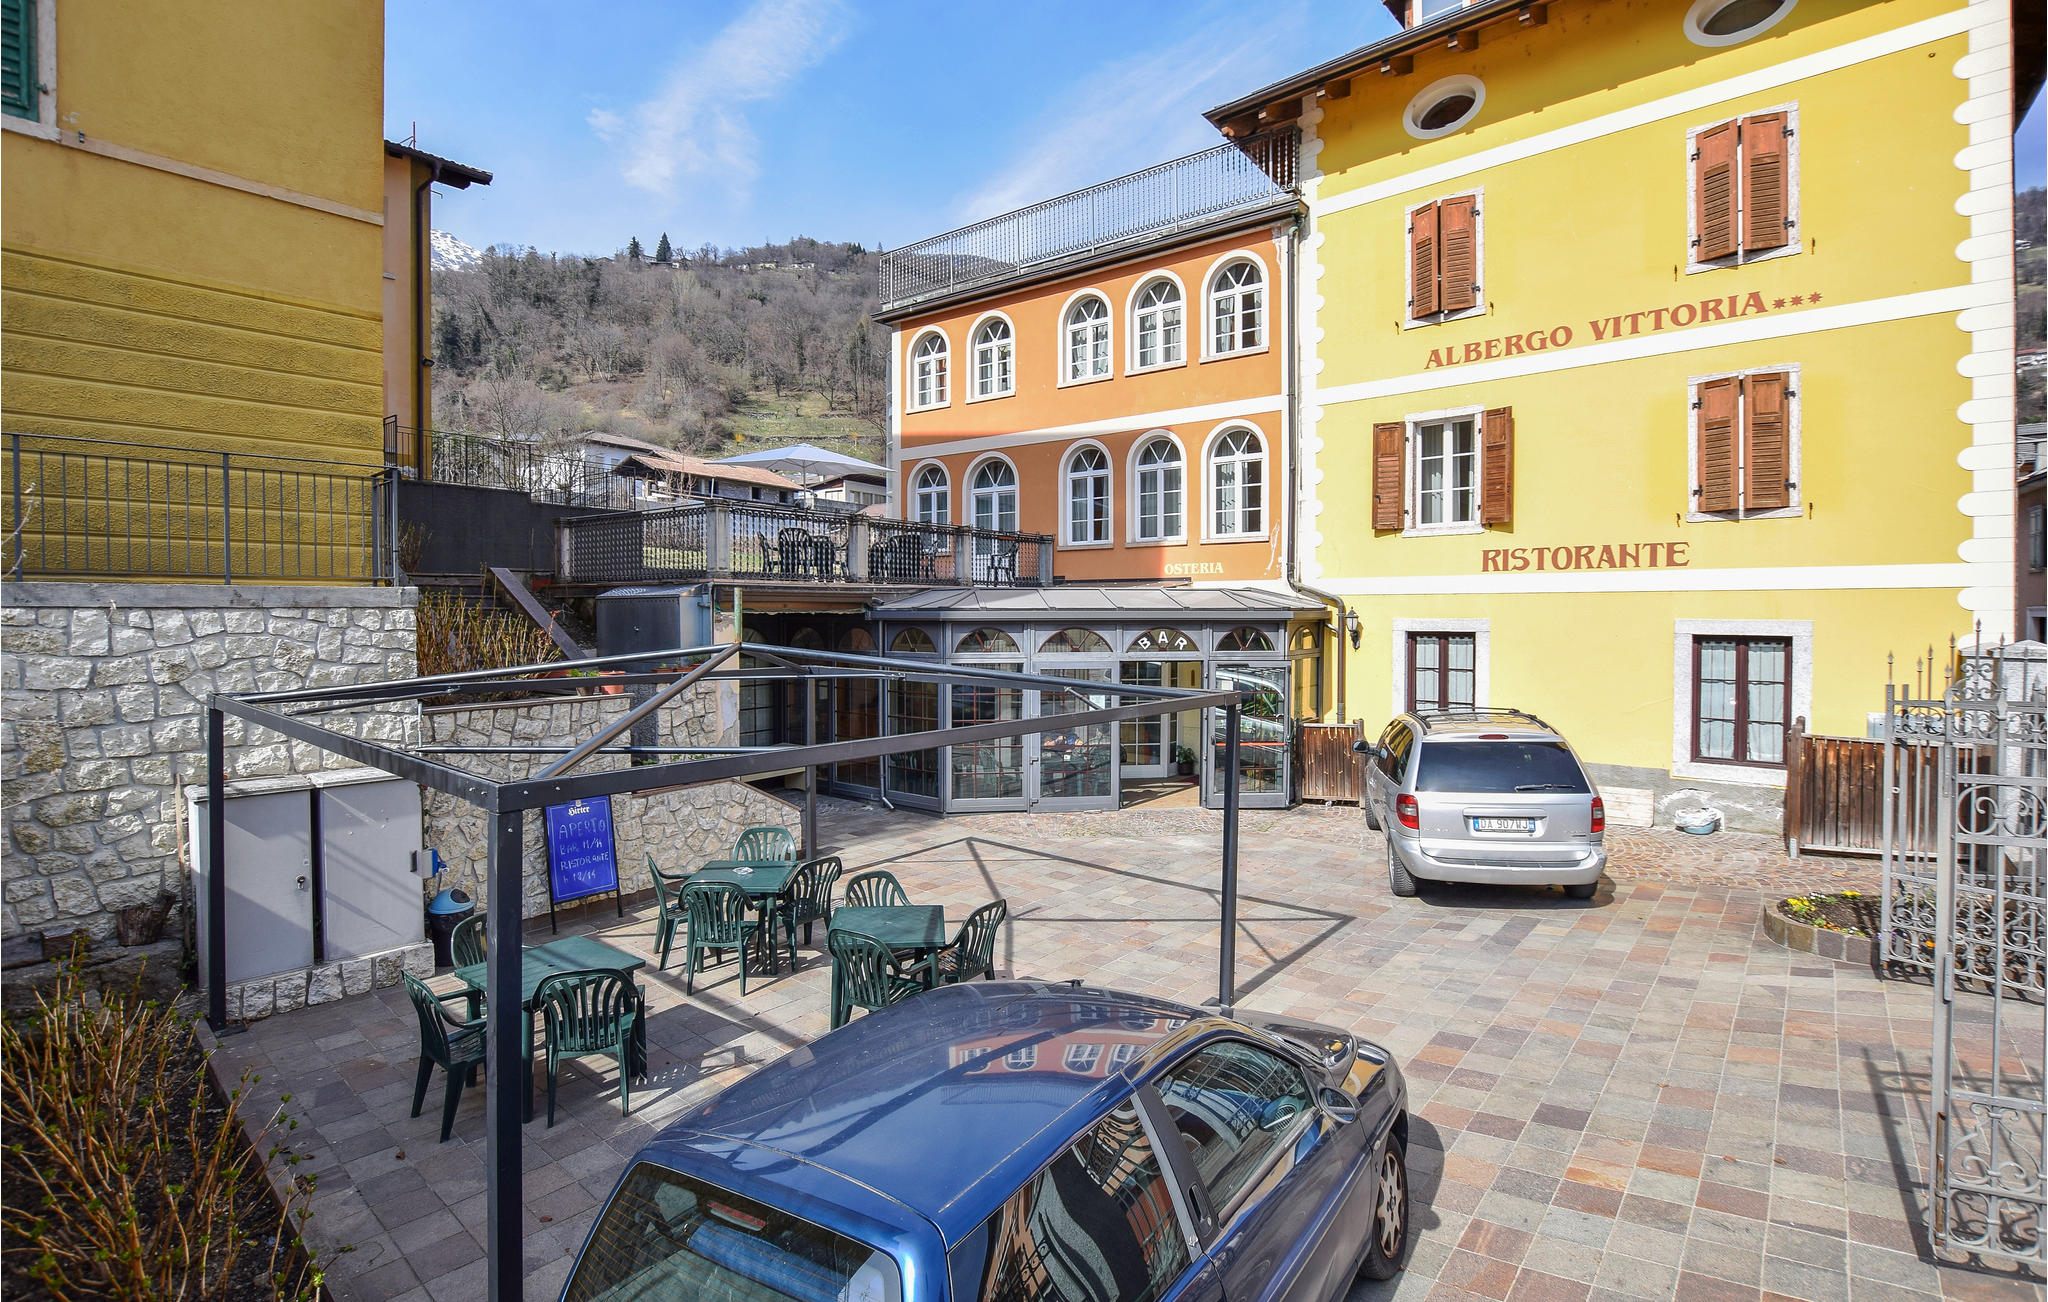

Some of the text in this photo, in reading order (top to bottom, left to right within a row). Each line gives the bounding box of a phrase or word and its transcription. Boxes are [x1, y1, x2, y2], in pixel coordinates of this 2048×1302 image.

[1424, 290, 1769, 369] ALBERGO VITTORIA
[1481, 541, 1691, 573] RISTORANTE
[1164, 562, 1224, 575] OSTERIA
[1138, 631, 1187, 650] BAR
[560, 818, 606, 839] APERTO
